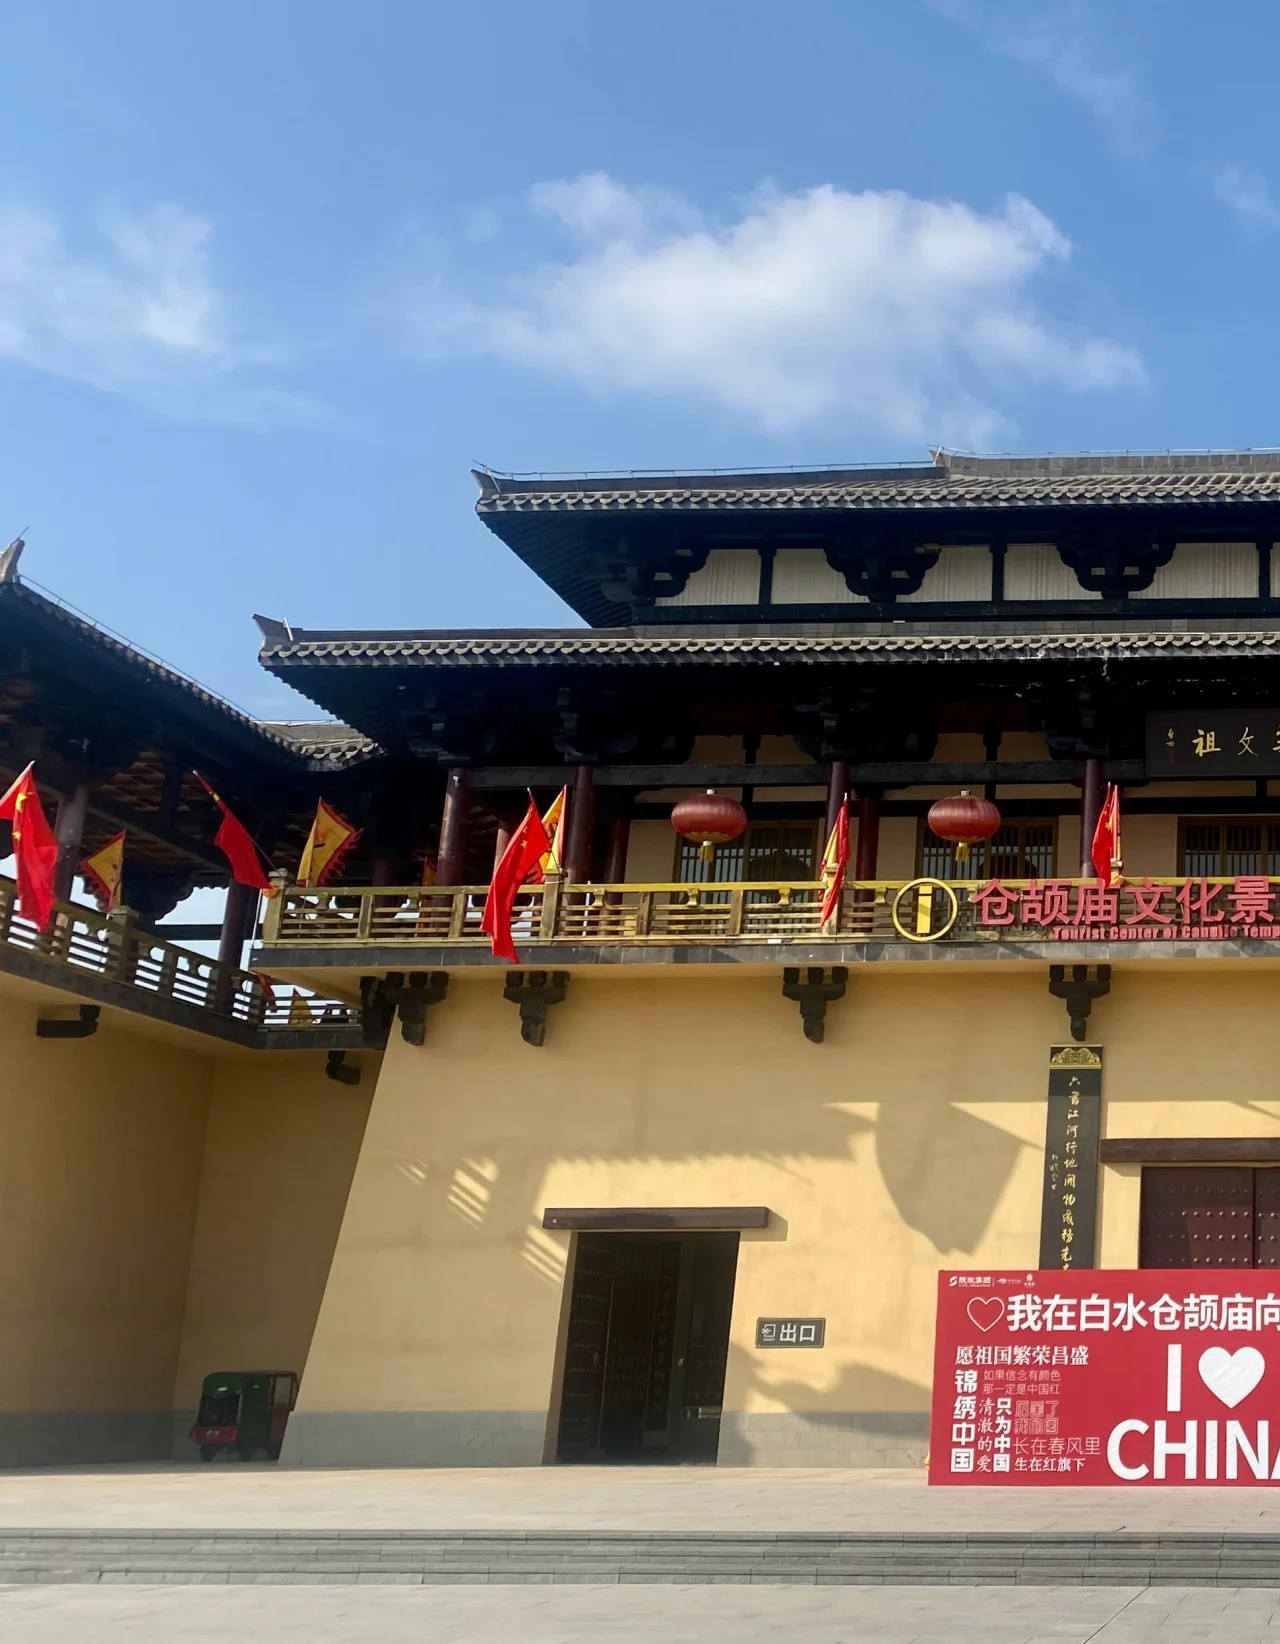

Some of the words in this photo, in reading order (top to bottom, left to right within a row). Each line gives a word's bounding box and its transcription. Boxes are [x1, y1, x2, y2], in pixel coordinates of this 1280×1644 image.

[1053, 926, 1106, 940] Tourist
[1109, 926, 1159, 940] Center
[1163, 926, 1178, 939] of
[779, 1322, 816, 1343] 出口
[954, 1345, 1089, 1366] 愿祖国繁荣昌盛
[983, 1369, 1061, 1382] 如果信念有颜色
[1167, 1344, 1182, 1412] I
[982, 1383, 1061, 1395] 那一定是中国红
[950, 1369, 978, 1473] 锦绣中国
[1014, 1417, 1059, 1435] 我的国
[976, 1398, 995, 1473] 清澈的爱
[993, 1397, 1012, 1473] 只为中国
[1013, 1436, 1101, 1456] 长在春风里
[1014, 1457, 1086, 1473] 生在红旗下
